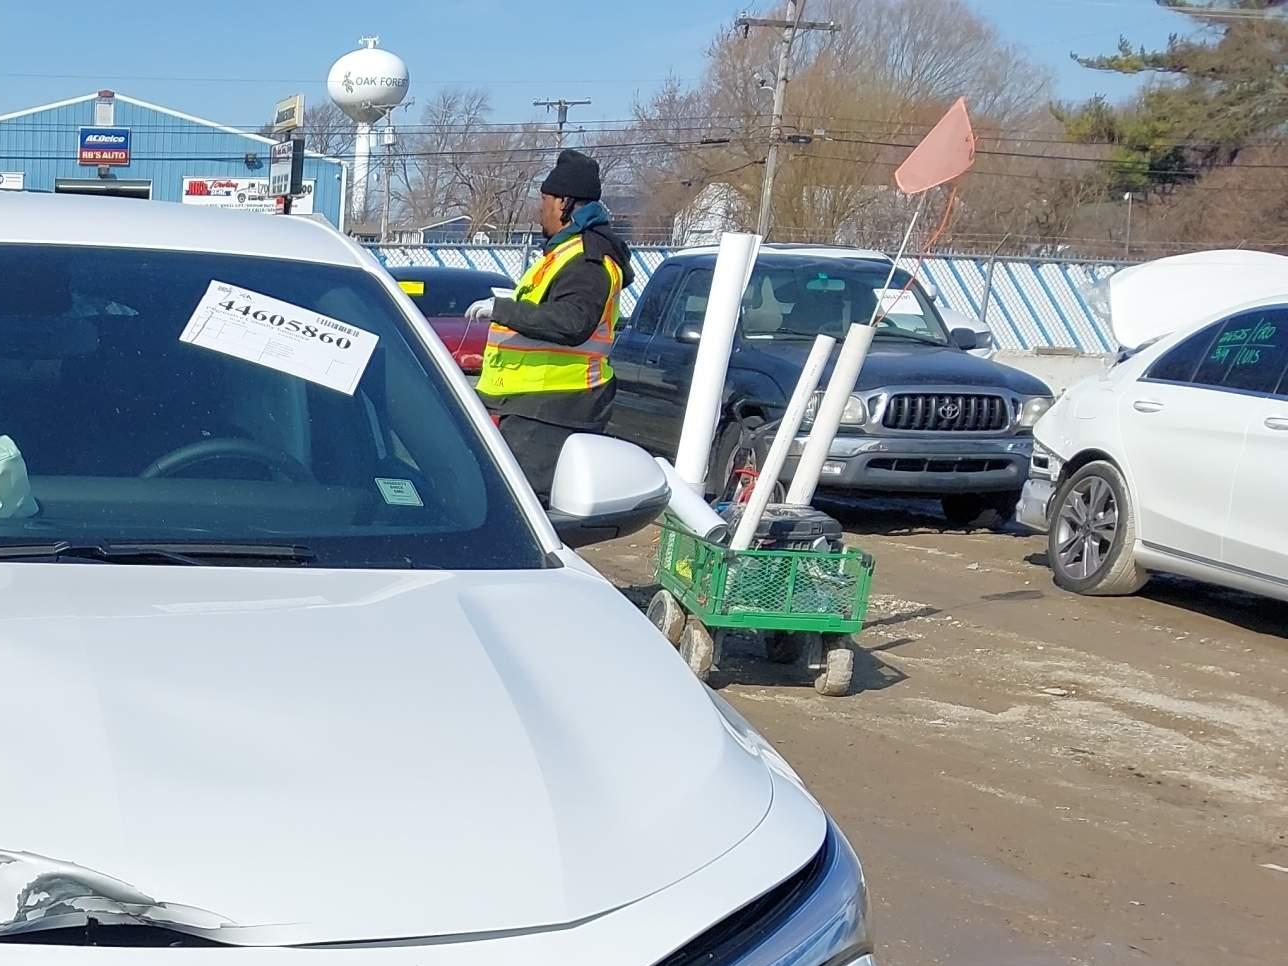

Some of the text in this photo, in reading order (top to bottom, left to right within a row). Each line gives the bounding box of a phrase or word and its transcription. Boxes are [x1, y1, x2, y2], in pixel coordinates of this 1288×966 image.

[355, 77, 377, 86] OAK
[85, 134, 126, 143] ACDelco
[102, 151, 126, 159] AUTO
[218, 300, 352, 350] 44605860
